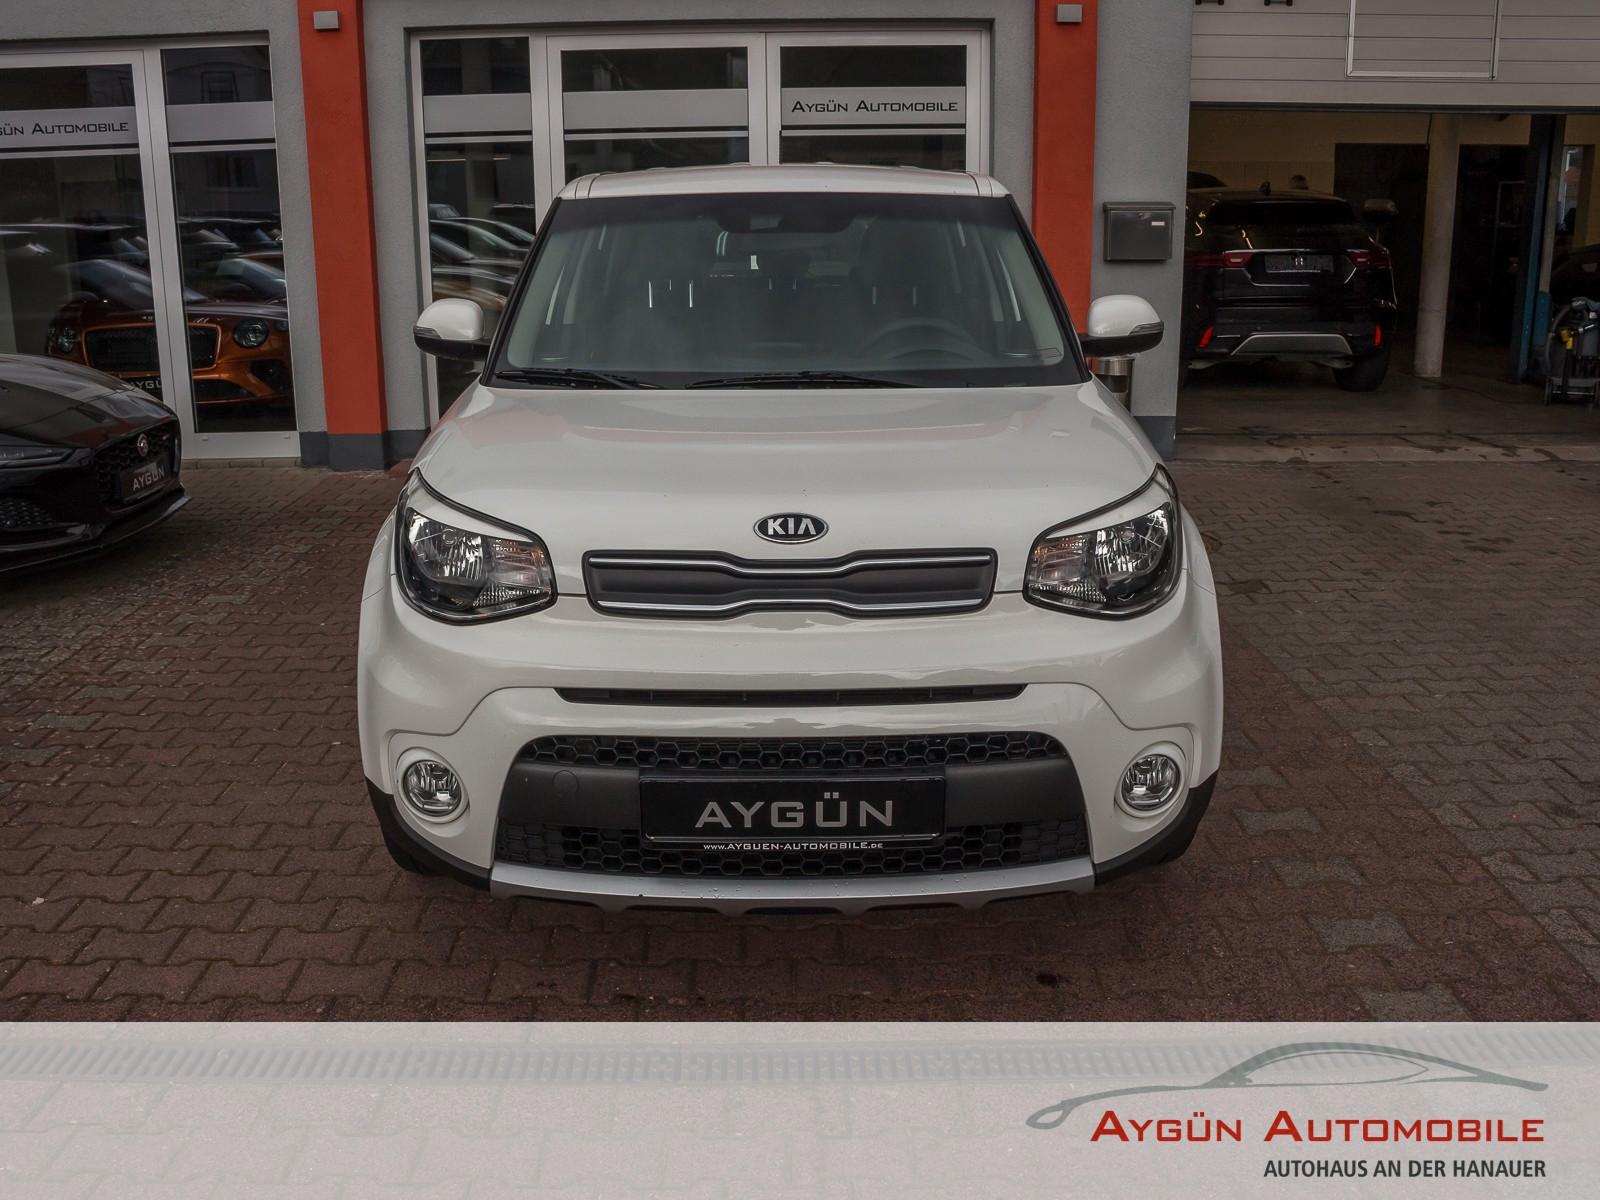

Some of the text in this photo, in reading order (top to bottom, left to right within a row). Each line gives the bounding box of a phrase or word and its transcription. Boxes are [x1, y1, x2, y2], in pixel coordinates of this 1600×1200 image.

[791, 99, 958, 113] AYGÜN AUTOMOBILE
[32, 122, 129, 135] AUTOMOBILE
[767, 517, 817, 536] KIA
[694, 791, 894, 829] AYGÜN
